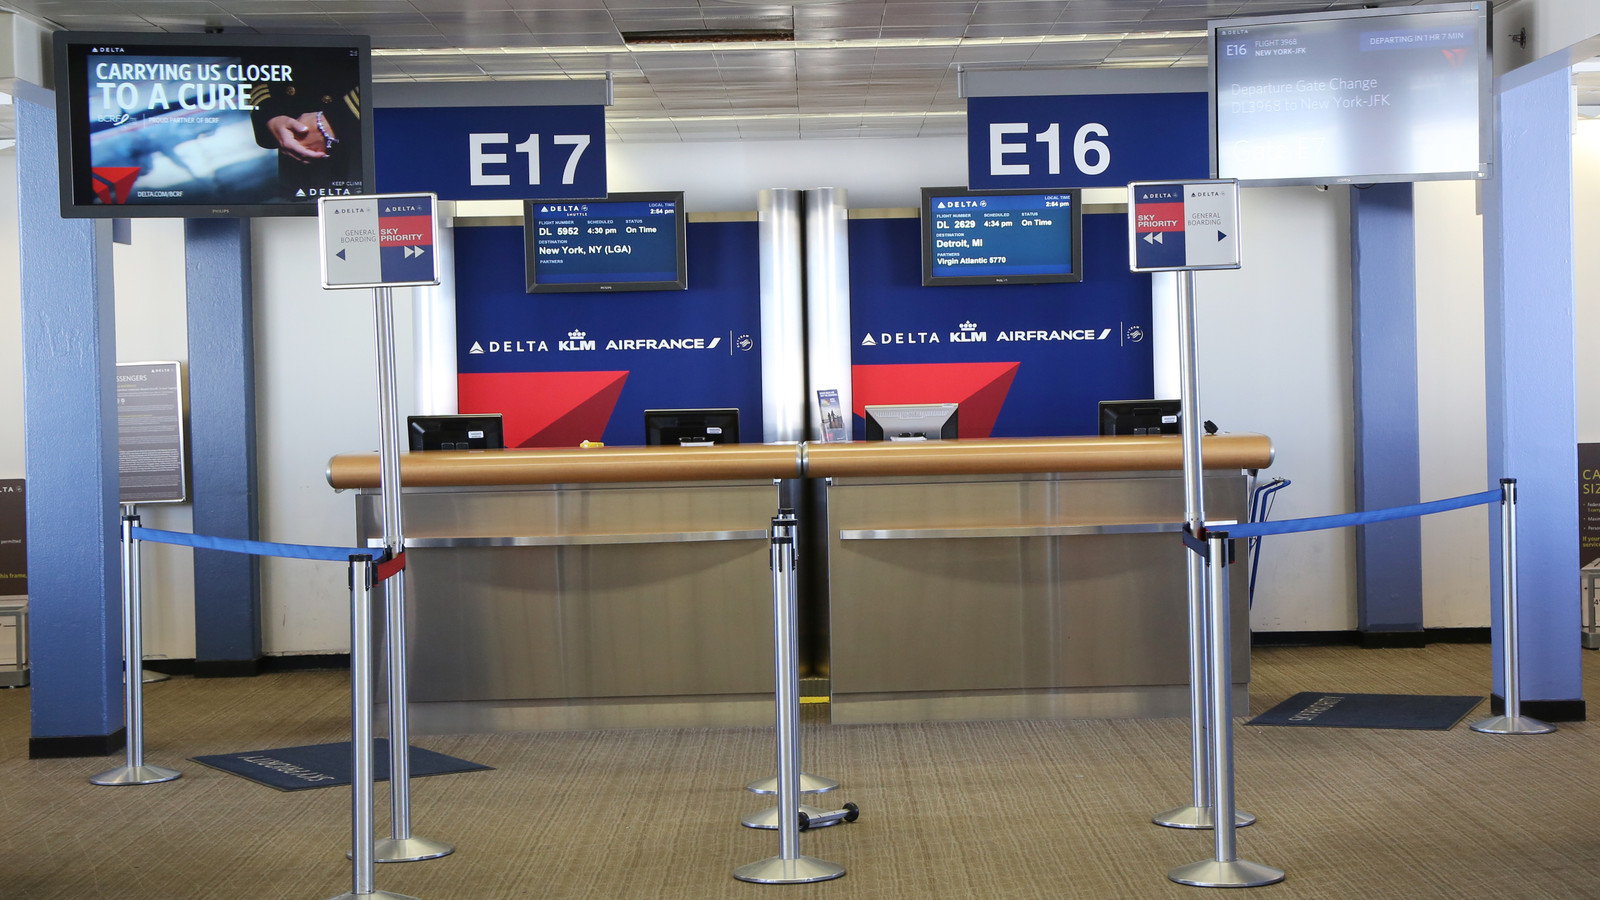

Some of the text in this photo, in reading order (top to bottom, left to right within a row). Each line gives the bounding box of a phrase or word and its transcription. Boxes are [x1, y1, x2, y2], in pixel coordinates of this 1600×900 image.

[1370, 36, 1413, 44] DEPARTING
[1227, 44, 1247, 56] E16
[96, 63, 293, 81] CARRYING US CLOSER
[1232, 77, 1377, 96] Departure Gate Change
[96, 82, 259, 111] TO A CURE.
[1232, 94, 1390, 114] DL3968 to New York-JFK
[990, 123, 1110, 175] E16
[469, 133, 590, 185] E17
[137, 190, 183, 198] DELTA.COM/BCRF
[310, 188, 350, 196] DELTA
[954, 220, 975, 228] 2629
[539, 227, 579, 236] DL 5952
[381, 234, 423, 242] PRIORITY
[937, 240, 970, 248] Detroit,
[562, 246, 586, 255] York,
[589, 246, 602, 254] NY
[605, 245, 631, 255] (LGA)
[937, 258, 958, 266] Virgin
[882, 330, 1095, 344] DELTA KLM AIRFRANCE
[489, 339, 704, 352] DELTA KLM AIRFRANCE
